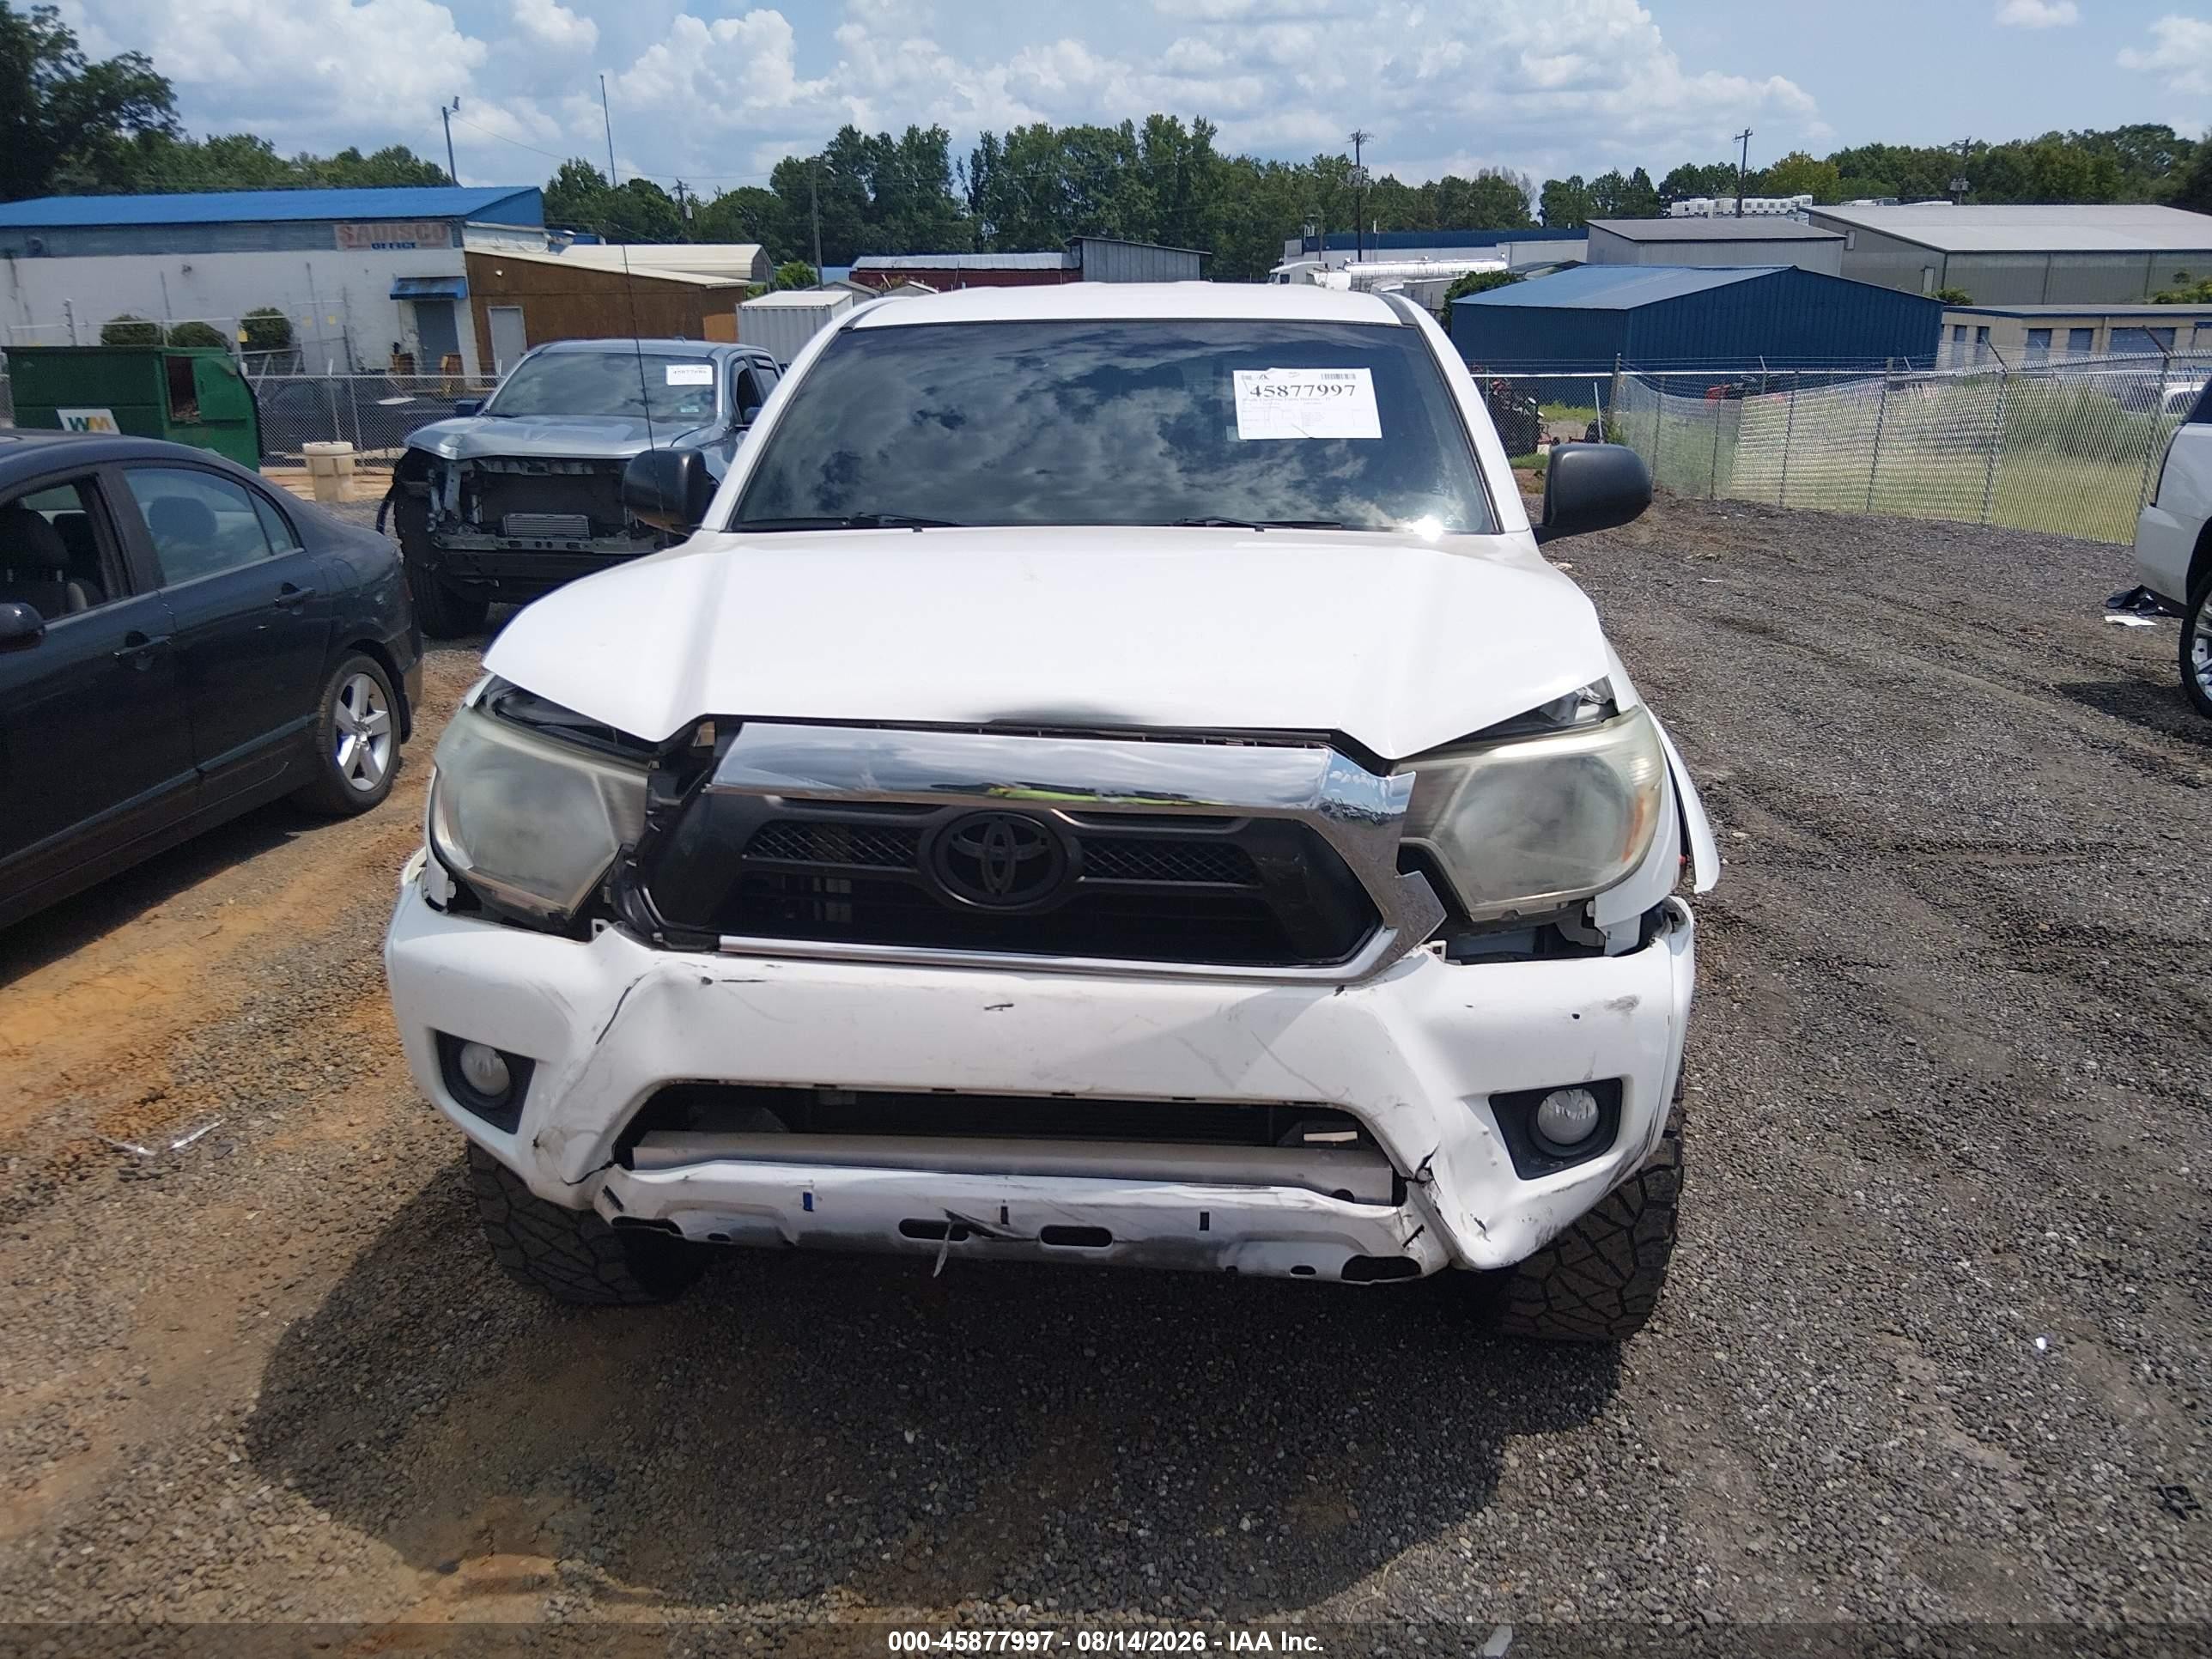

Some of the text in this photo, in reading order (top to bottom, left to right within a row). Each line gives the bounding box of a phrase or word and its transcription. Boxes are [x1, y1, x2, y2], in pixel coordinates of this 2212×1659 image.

[338, 224, 447, 241] SADISCO
[371, 241, 416, 250] OFFICE
[1249, 384, 1356, 398] 45877997
[67, 416, 112, 433] WM
